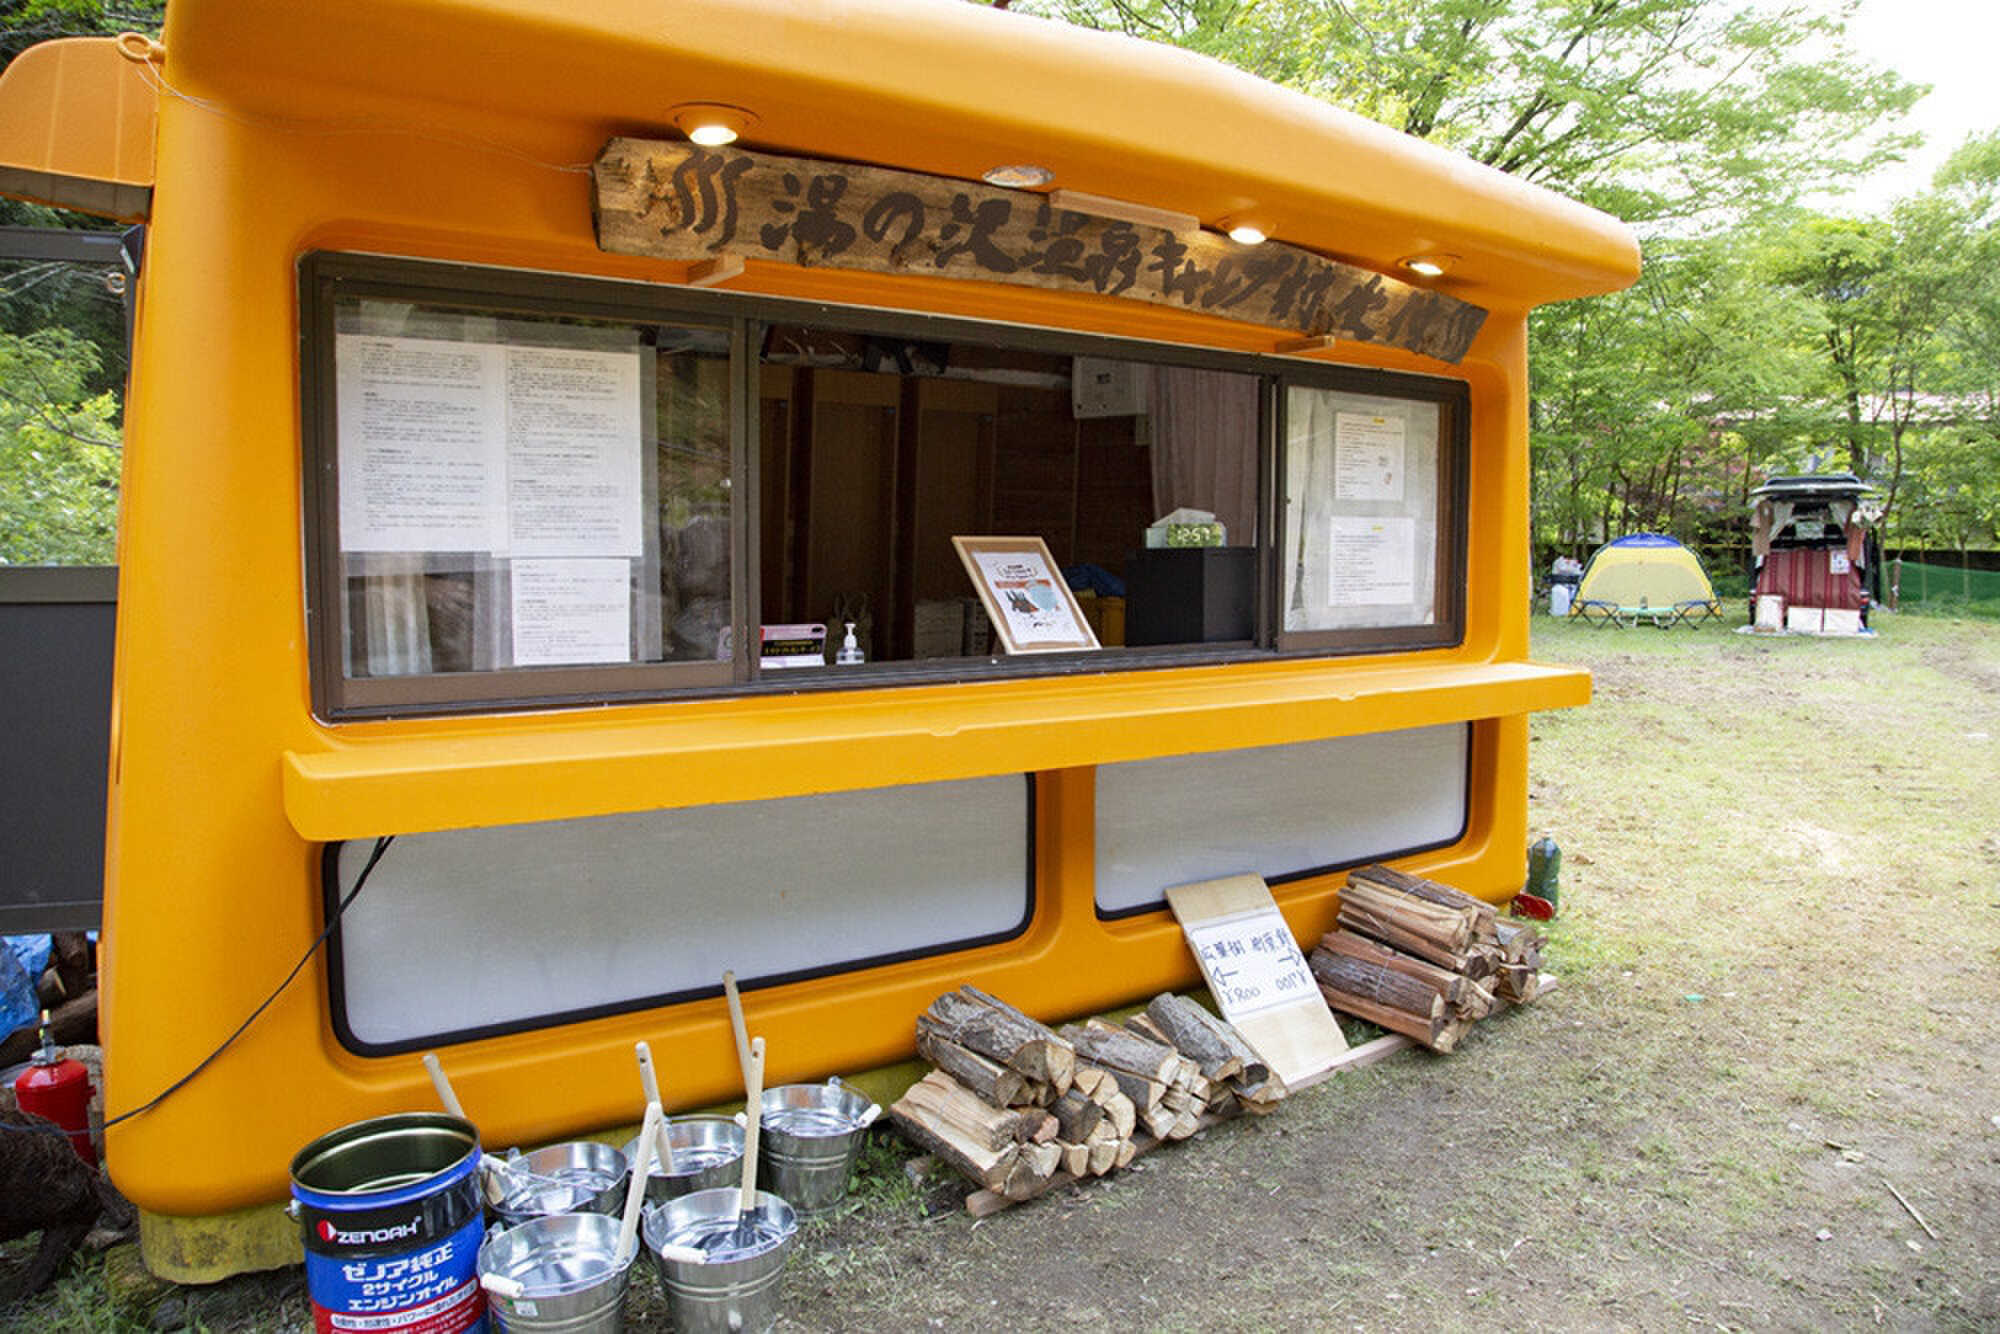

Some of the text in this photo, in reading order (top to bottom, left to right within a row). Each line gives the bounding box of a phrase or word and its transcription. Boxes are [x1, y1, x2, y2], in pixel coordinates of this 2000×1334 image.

[337, 1222, 418, 1245] ZENOAH
[342, 1240, 454, 1282] ゼノア純正
[348, 1275, 459, 1312] エンジンオイル
[362, 1269, 440, 1297] 2サイクル
